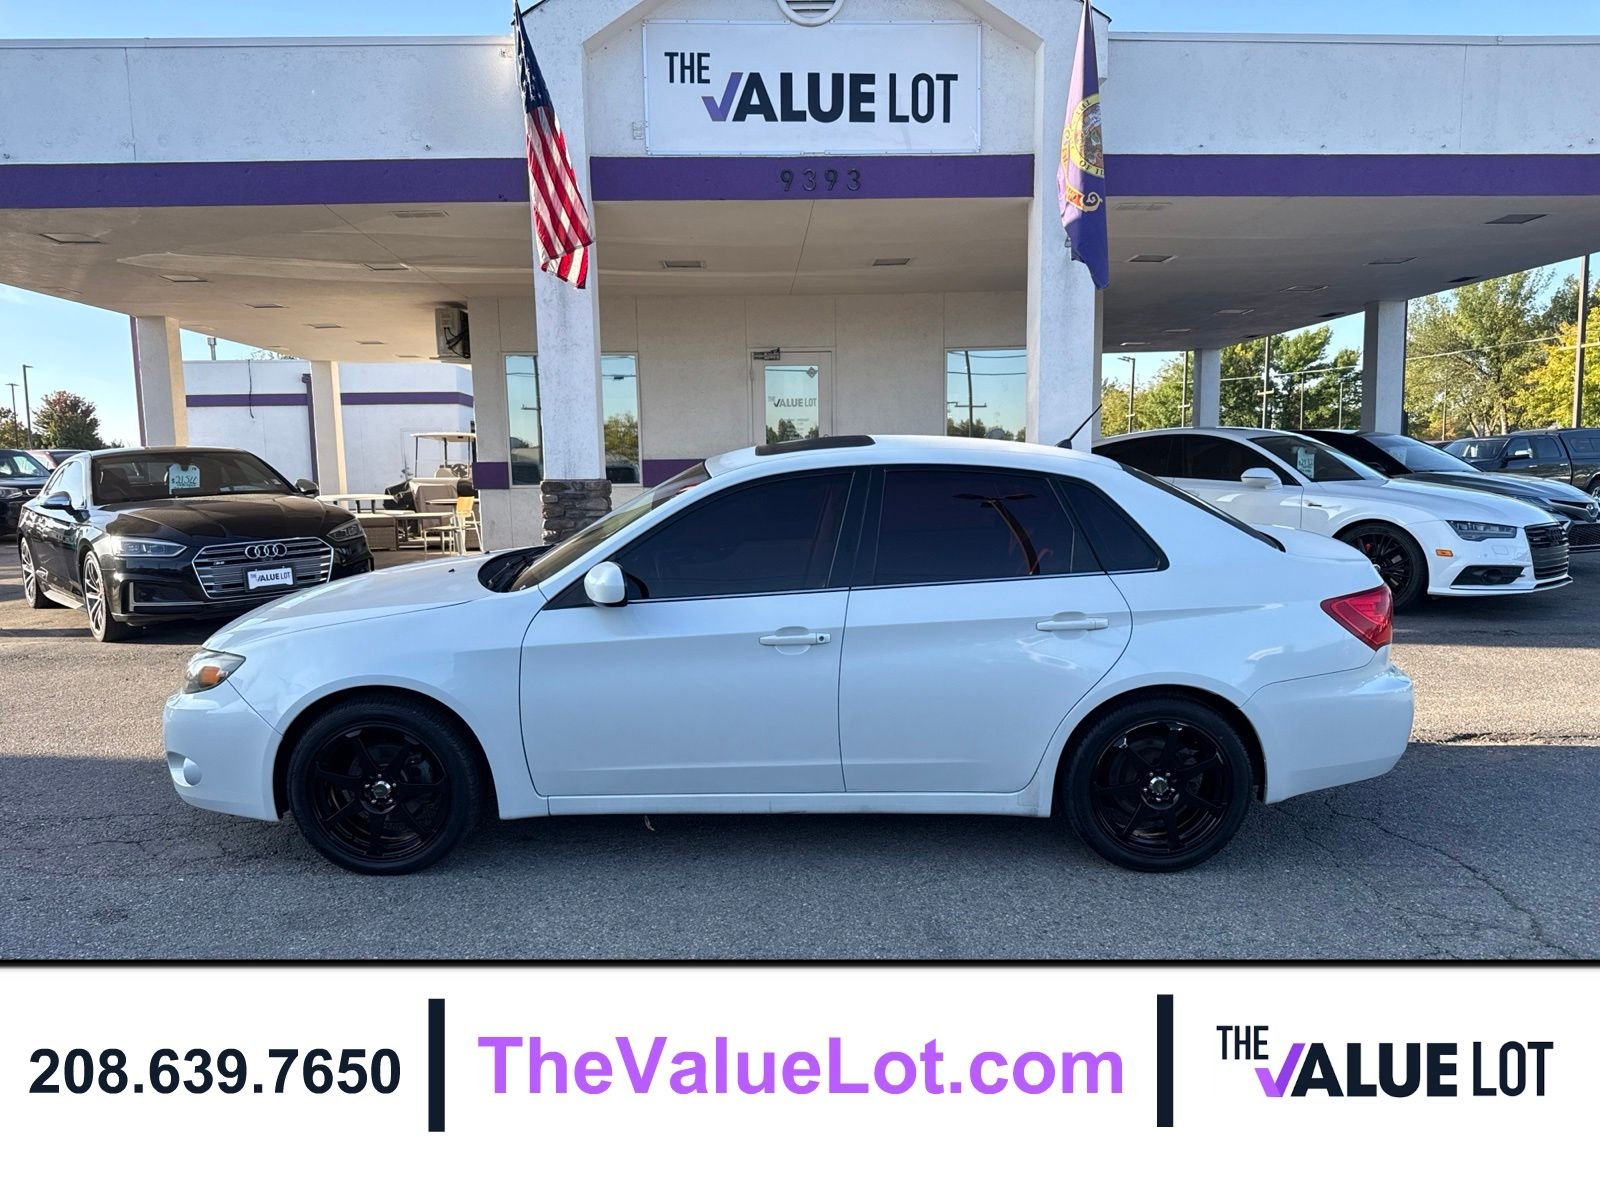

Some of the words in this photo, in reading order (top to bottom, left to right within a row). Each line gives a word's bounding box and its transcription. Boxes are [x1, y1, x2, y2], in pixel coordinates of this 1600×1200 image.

[664, 52, 710, 84] THE
[701, 72, 876, 123] VALUE
[888, 73, 959, 123] LOT
[780, 168, 861, 192] 9393
[774, 398, 804, 407] VALUE
[804, 398, 817, 407] LOT
[257, 572, 280, 582] VALUE
[280, 572, 290, 580] LOT
